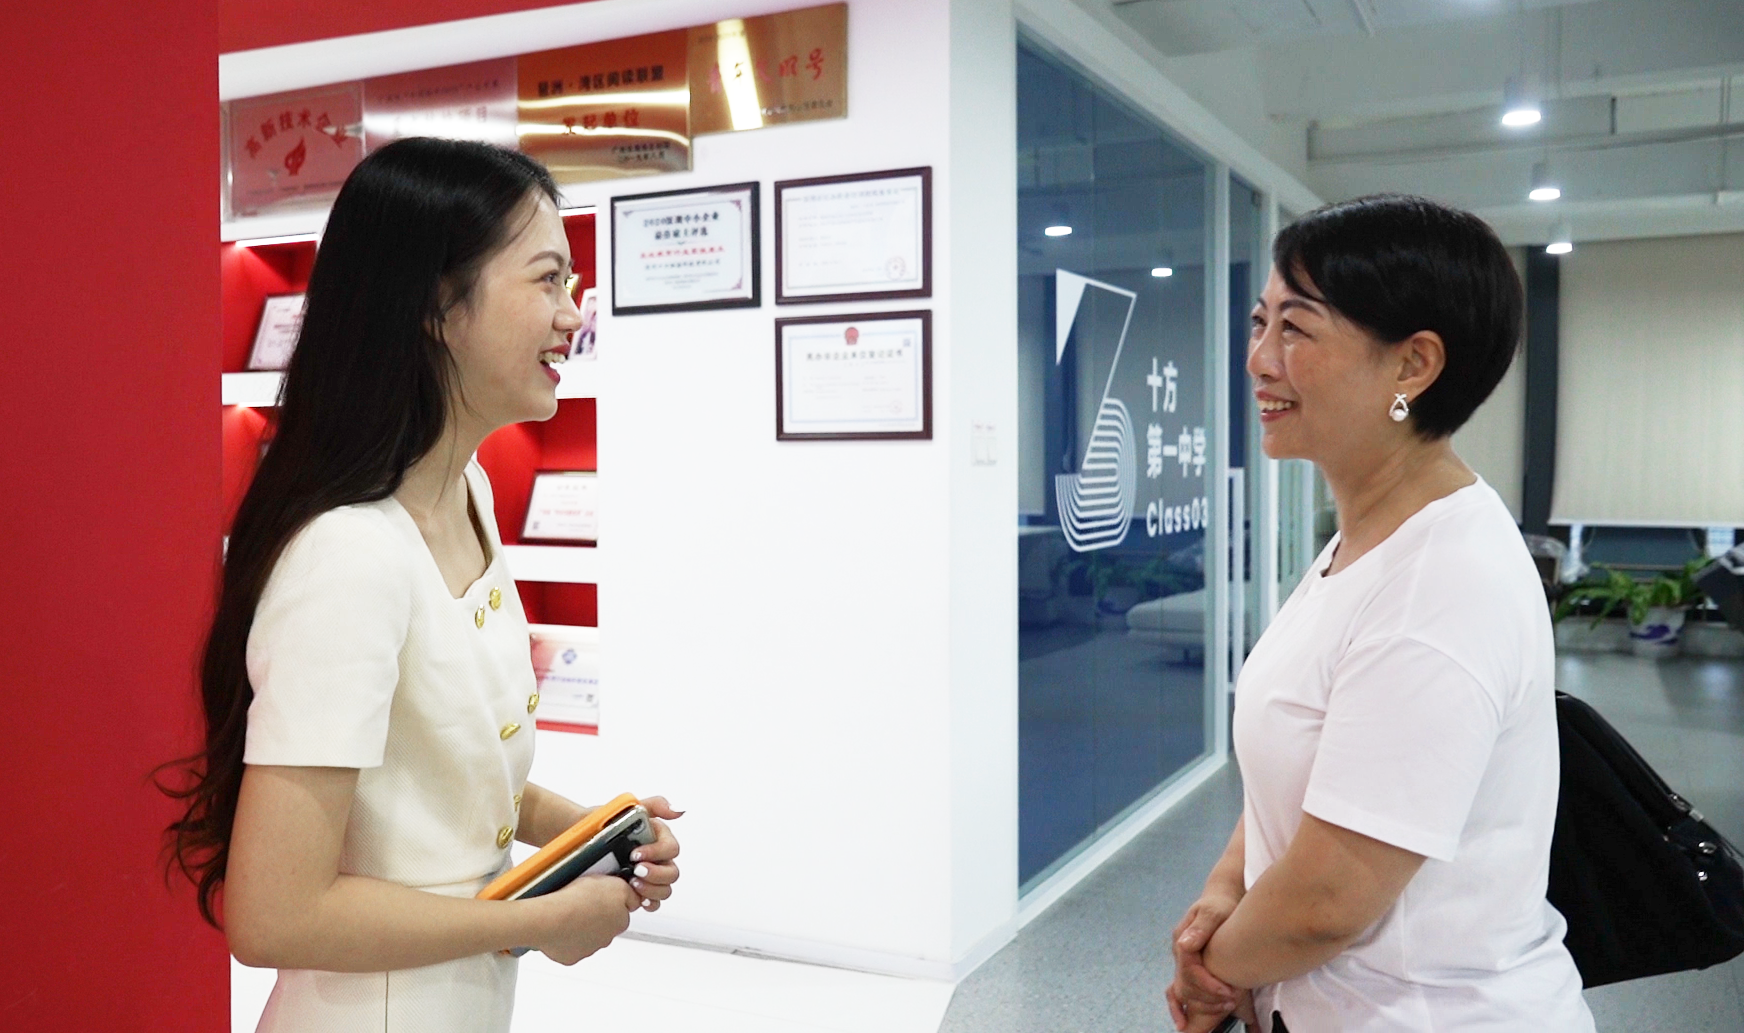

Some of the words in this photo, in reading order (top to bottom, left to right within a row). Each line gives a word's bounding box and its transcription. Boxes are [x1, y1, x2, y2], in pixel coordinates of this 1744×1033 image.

[1146, 357, 1179, 413] 十方
[1146, 423, 1207, 479] 第一中学
[1146, 497, 1209, 538] Class03
